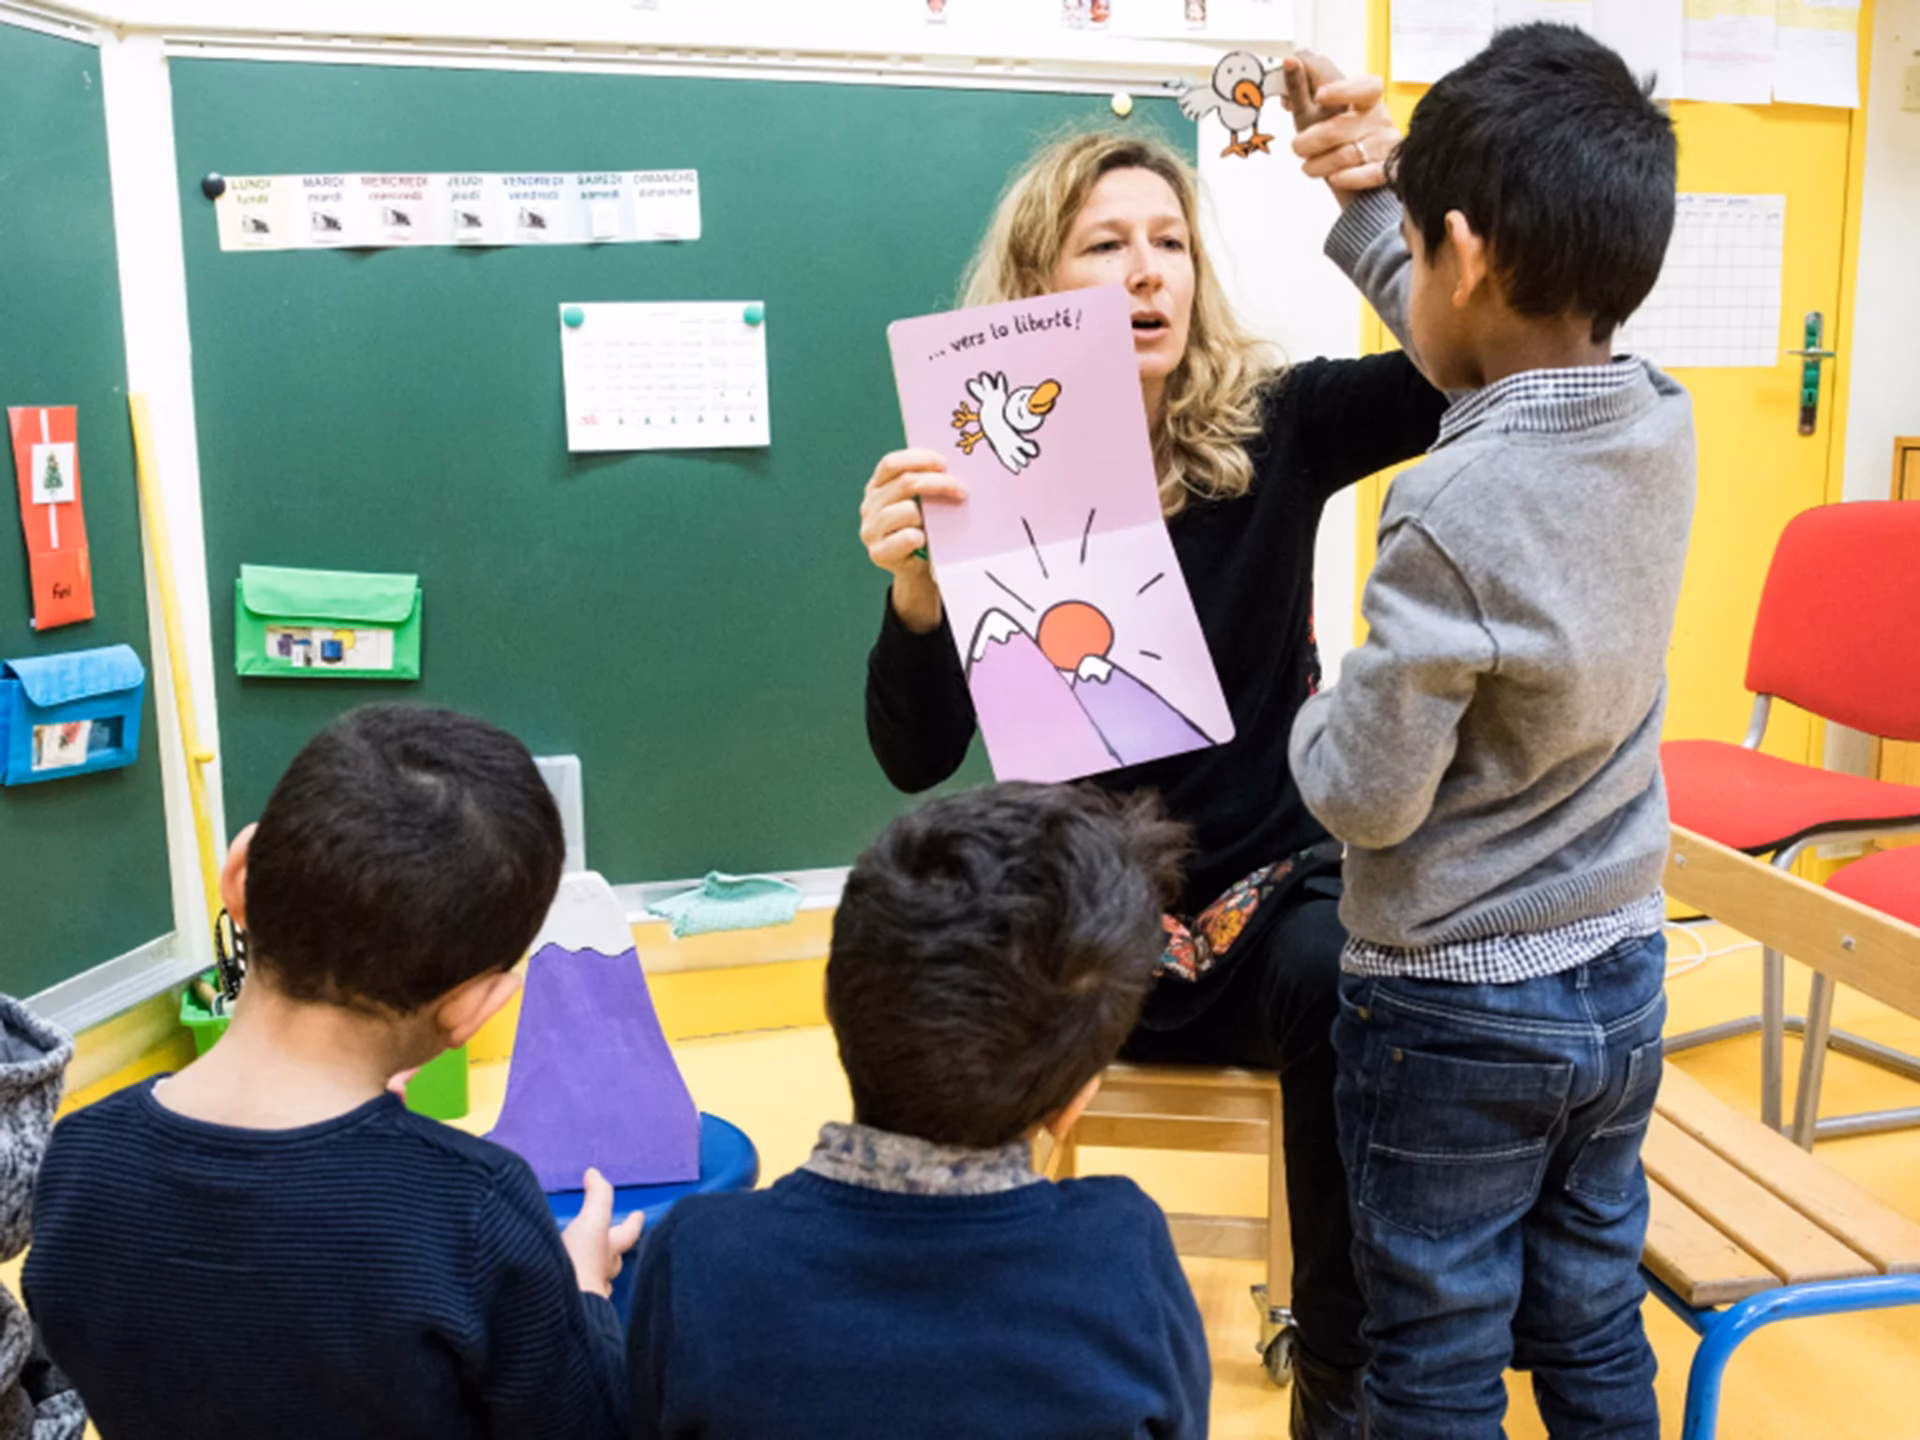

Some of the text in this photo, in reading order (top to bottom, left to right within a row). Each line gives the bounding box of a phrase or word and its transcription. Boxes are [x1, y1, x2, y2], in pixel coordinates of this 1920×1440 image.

[231, 173, 695, 190] LUNDI MARDI MERCREDI JEUDI VENDREDI SAMEDI DIMANCHE
[236, 194, 269, 204] lundi
[307, 192, 342, 202] mardi
[368, 191, 423, 201] mercredi
[450, 190, 481, 202] jeudi
[508, 190, 559, 200] vendredi
[949, 332, 986, 353] vers
